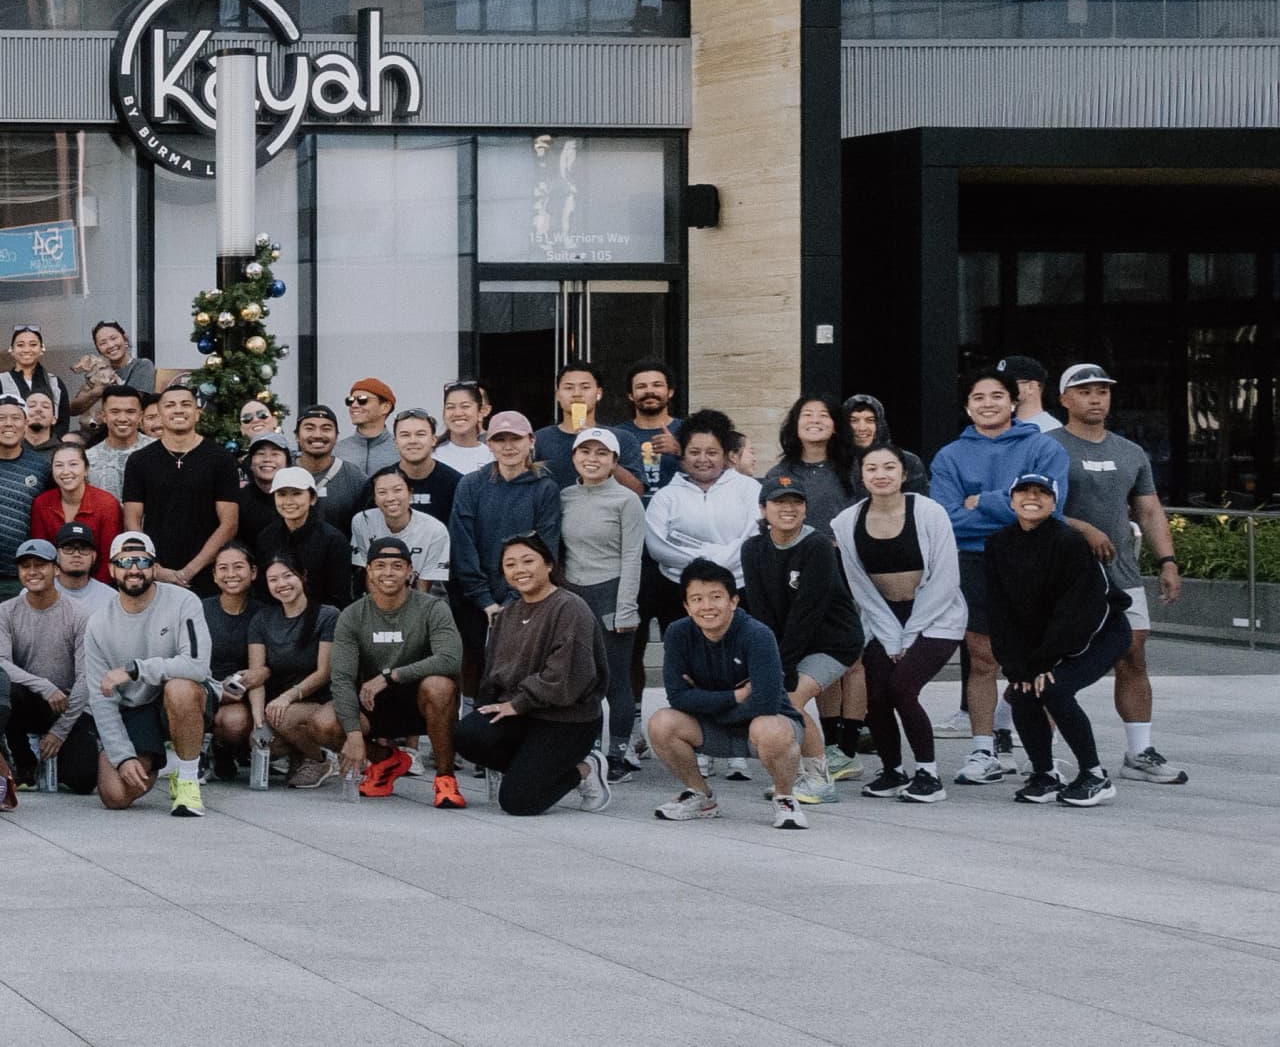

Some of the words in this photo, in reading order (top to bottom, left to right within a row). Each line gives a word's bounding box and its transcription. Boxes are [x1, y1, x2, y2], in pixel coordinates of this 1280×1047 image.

[152, 10, 421, 156] Kyah
[123, 95, 140, 119] BY
[138, 126, 192, 171] BURMA
[529, 232, 549, 244] 151
[606, 232, 631, 245] Way
[591, 250, 612, 261] 105
